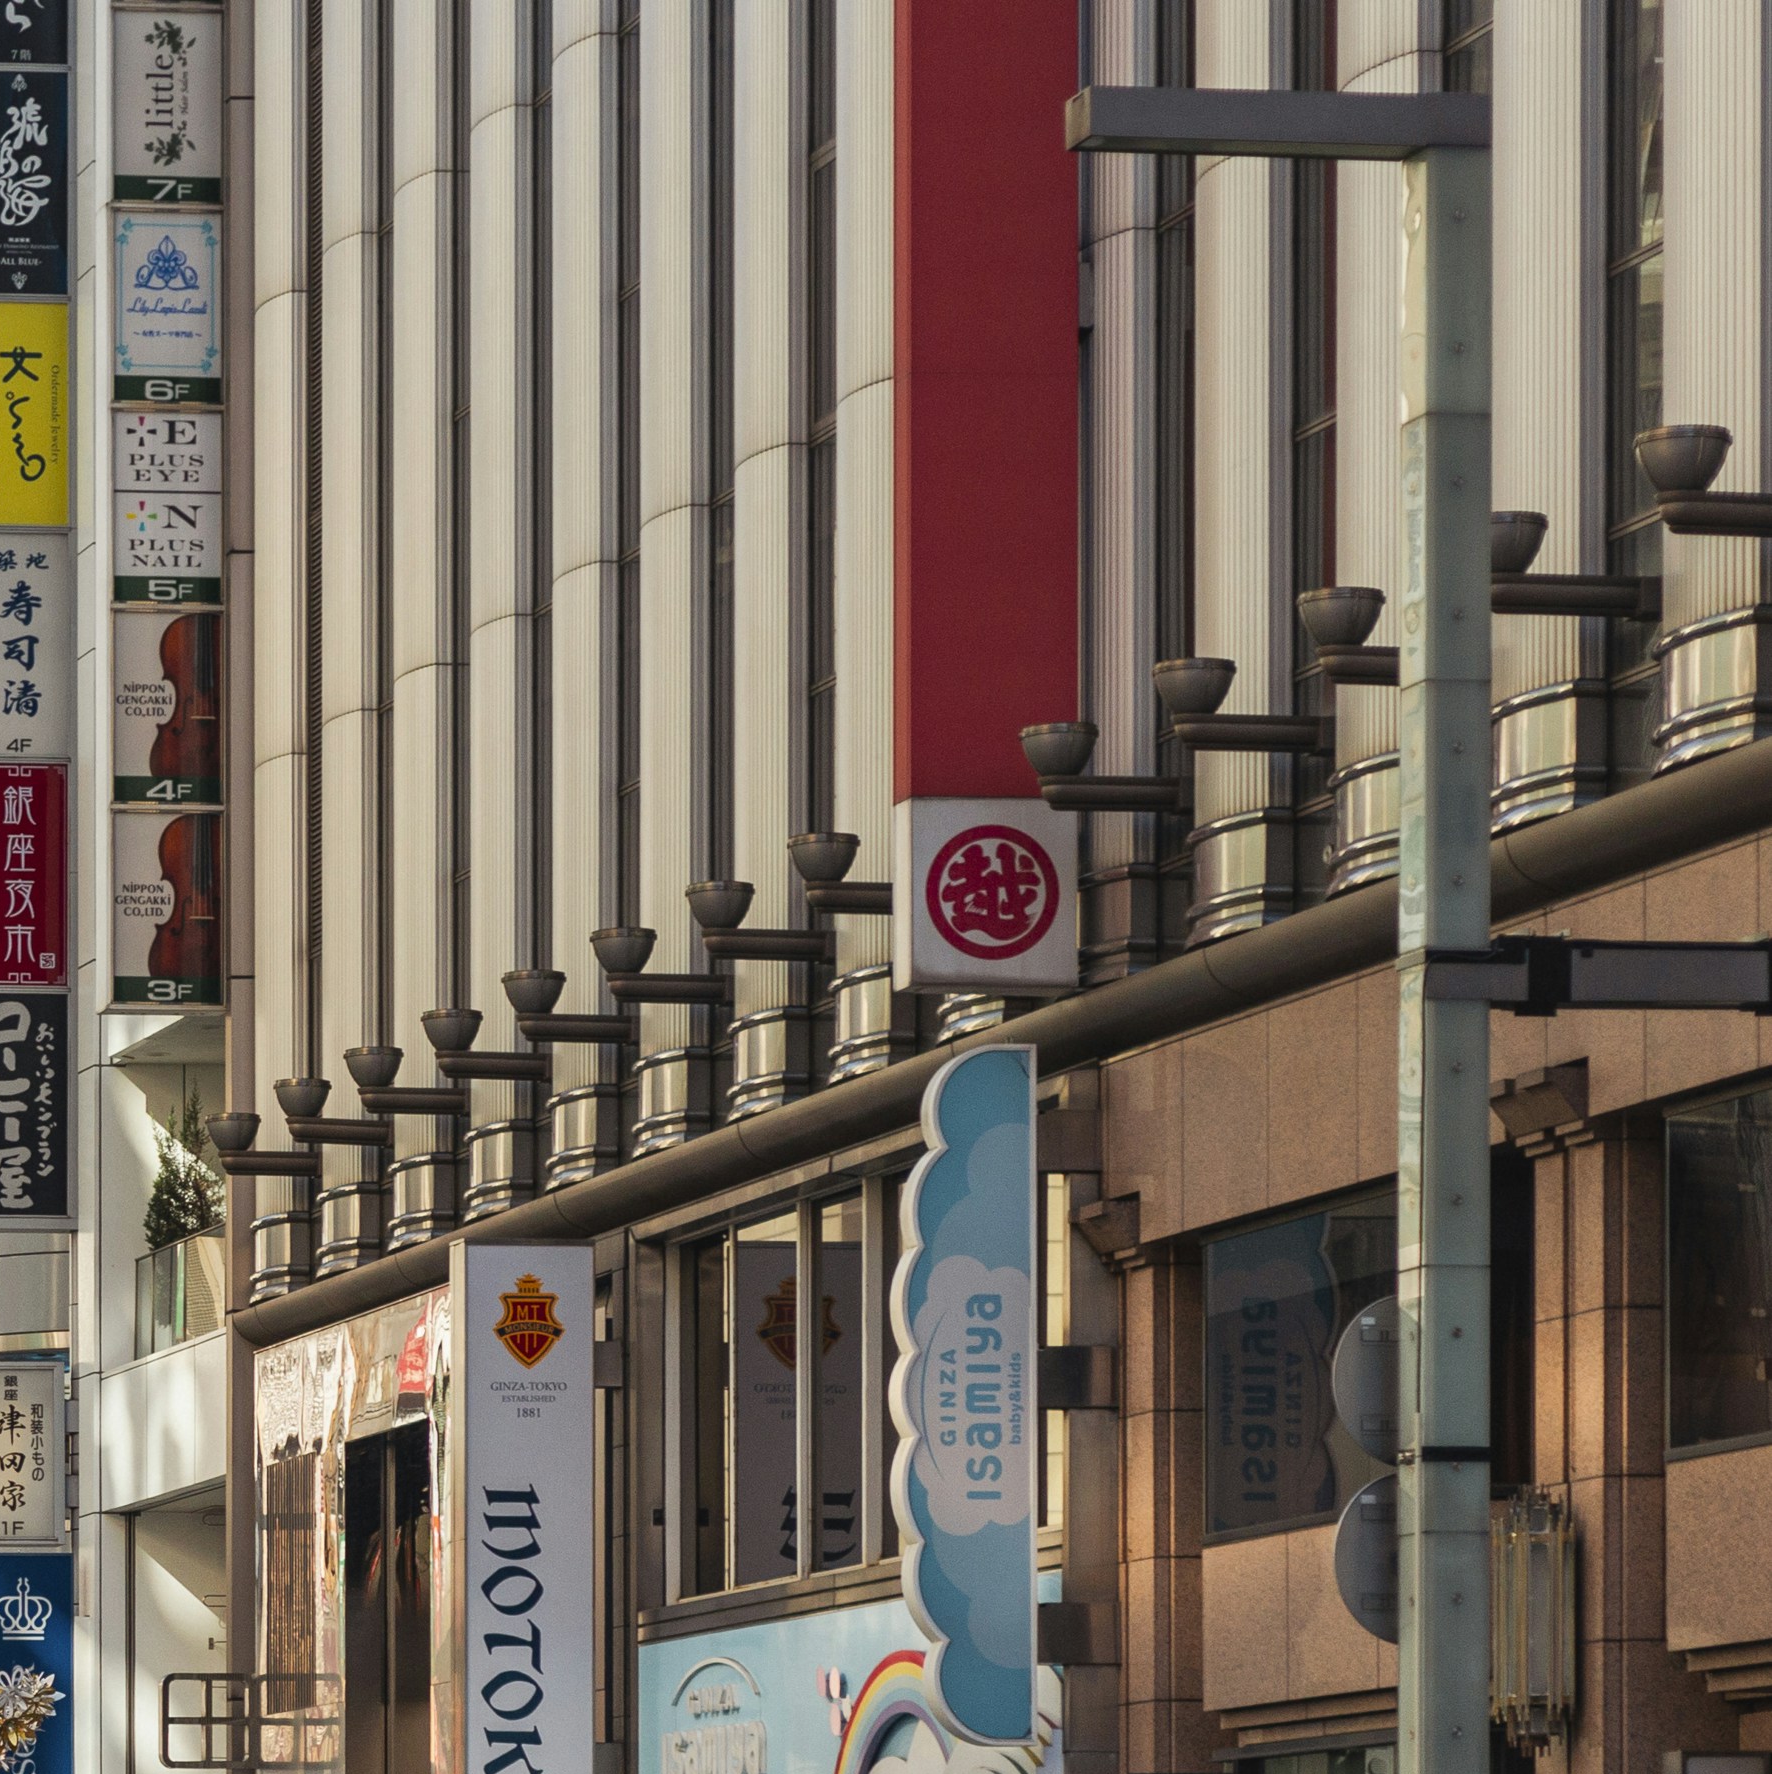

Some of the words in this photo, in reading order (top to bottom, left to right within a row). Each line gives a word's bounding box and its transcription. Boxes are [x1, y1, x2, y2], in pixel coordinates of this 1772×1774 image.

[145, 53, 175, 128] little
[146, 179, 194, 200] 7F
[49, 365, 60, 422] Ordermade
[144, 379, 191, 400] 6F
[163, 420, 197, 445] E
[129, 454, 205, 467] PLUS
[133, 469, 201, 483] EYE
[163, 505, 202, 530] N
[128, 539, 204, 552] PLUS
[132, 554, 203, 569] NAIL
[147, 579, 194, 601] 5F
[0, 580, 42, 719] 寿司清
[6, 738, 32, 753] 4F
[146, 779, 193, 801] 4F
[2, 784, 37, 965] 銀座夜市
[146, 979, 194, 1001] 3F
[515, 1303, 541, 1321] MT
[504, 1322, 556, 1336] MONSIEUR
[3, 1375, 19, 1402] 銀座
[490, 1381, 568, 1392] GINZA-TOKYO
[940, 1348, 959, 1448] GINZA
[1009, 1351, 1023, 1446] baby&kids
[515, 1406, 542, 1419] 1881
[30, 1402, 45, 1482] 和装小もの
[0, 1520, 25, 1536] 1F
